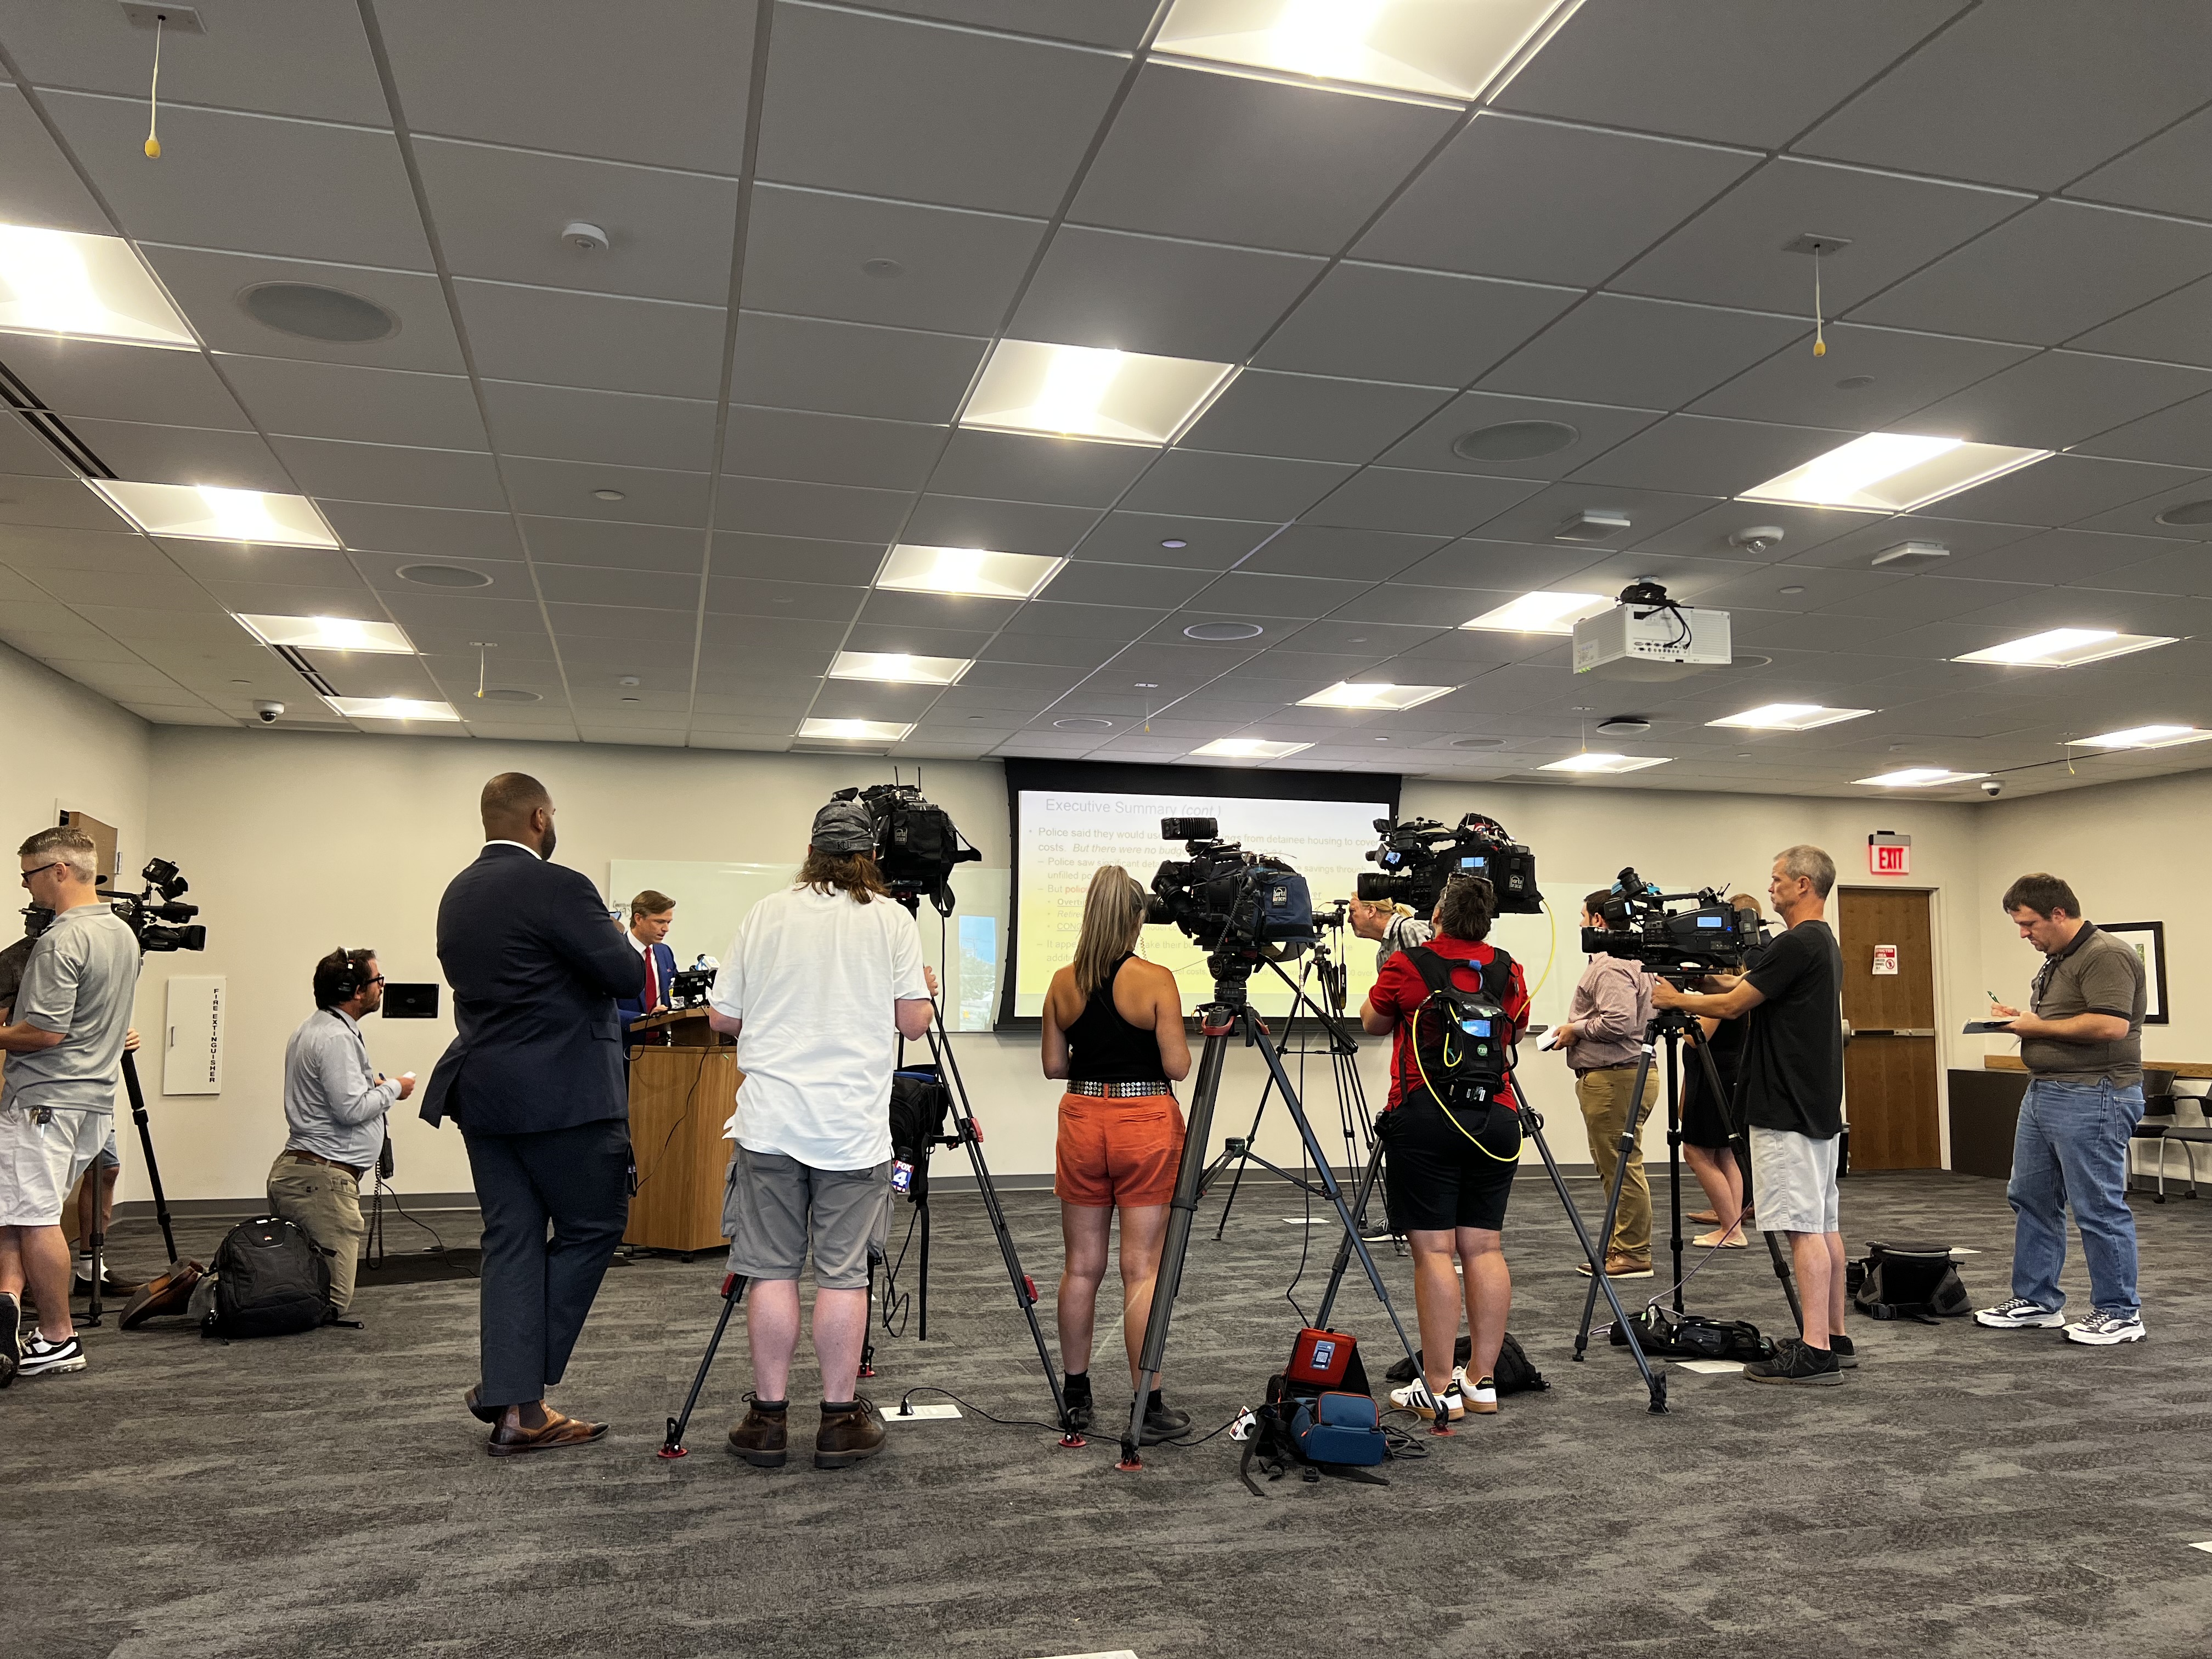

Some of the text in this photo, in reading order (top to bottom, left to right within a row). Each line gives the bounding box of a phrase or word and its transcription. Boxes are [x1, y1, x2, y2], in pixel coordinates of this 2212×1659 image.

[1046, 798, 1221, 819] Executive Summary (cont.)
[1039, 827, 1069, 837] Police
[1071, 829, 1091, 838] said
[1094, 830, 1114, 840] they
[1116, 831, 1144, 839] would
[837, 841, 850, 850] KU
[1244, 834, 1264, 843] from
[1267, 835, 1305, 844] detainee
[1307, 836, 1342, 847] housing
[1038, 843, 1066, 851] costs.
[1073, 844, 1089, 852] But
[1092, 844, 1116, 853] there
[1159, 847, 1187, 857] budge
[1048, 857, 1074, 866] Police
[1879, 848, 1904, 869] EXIT
[1048, 871, 1079, 879] unfilled
[1304, 865, 1334, 874] savings
[1336, 865, 1366, 873] through
[1048, 884, 1063, 893] But
[1047, 940, 1076, 950] It appe
[1163, 940, 1181, 949] their
[1186, 968, 1207, 977] costs,
[210, 1014, 218, 1083] EXTINGUISHER
[896, 1160, 912, 1172] FOX
[893, 1171, 907, 1187] 4
